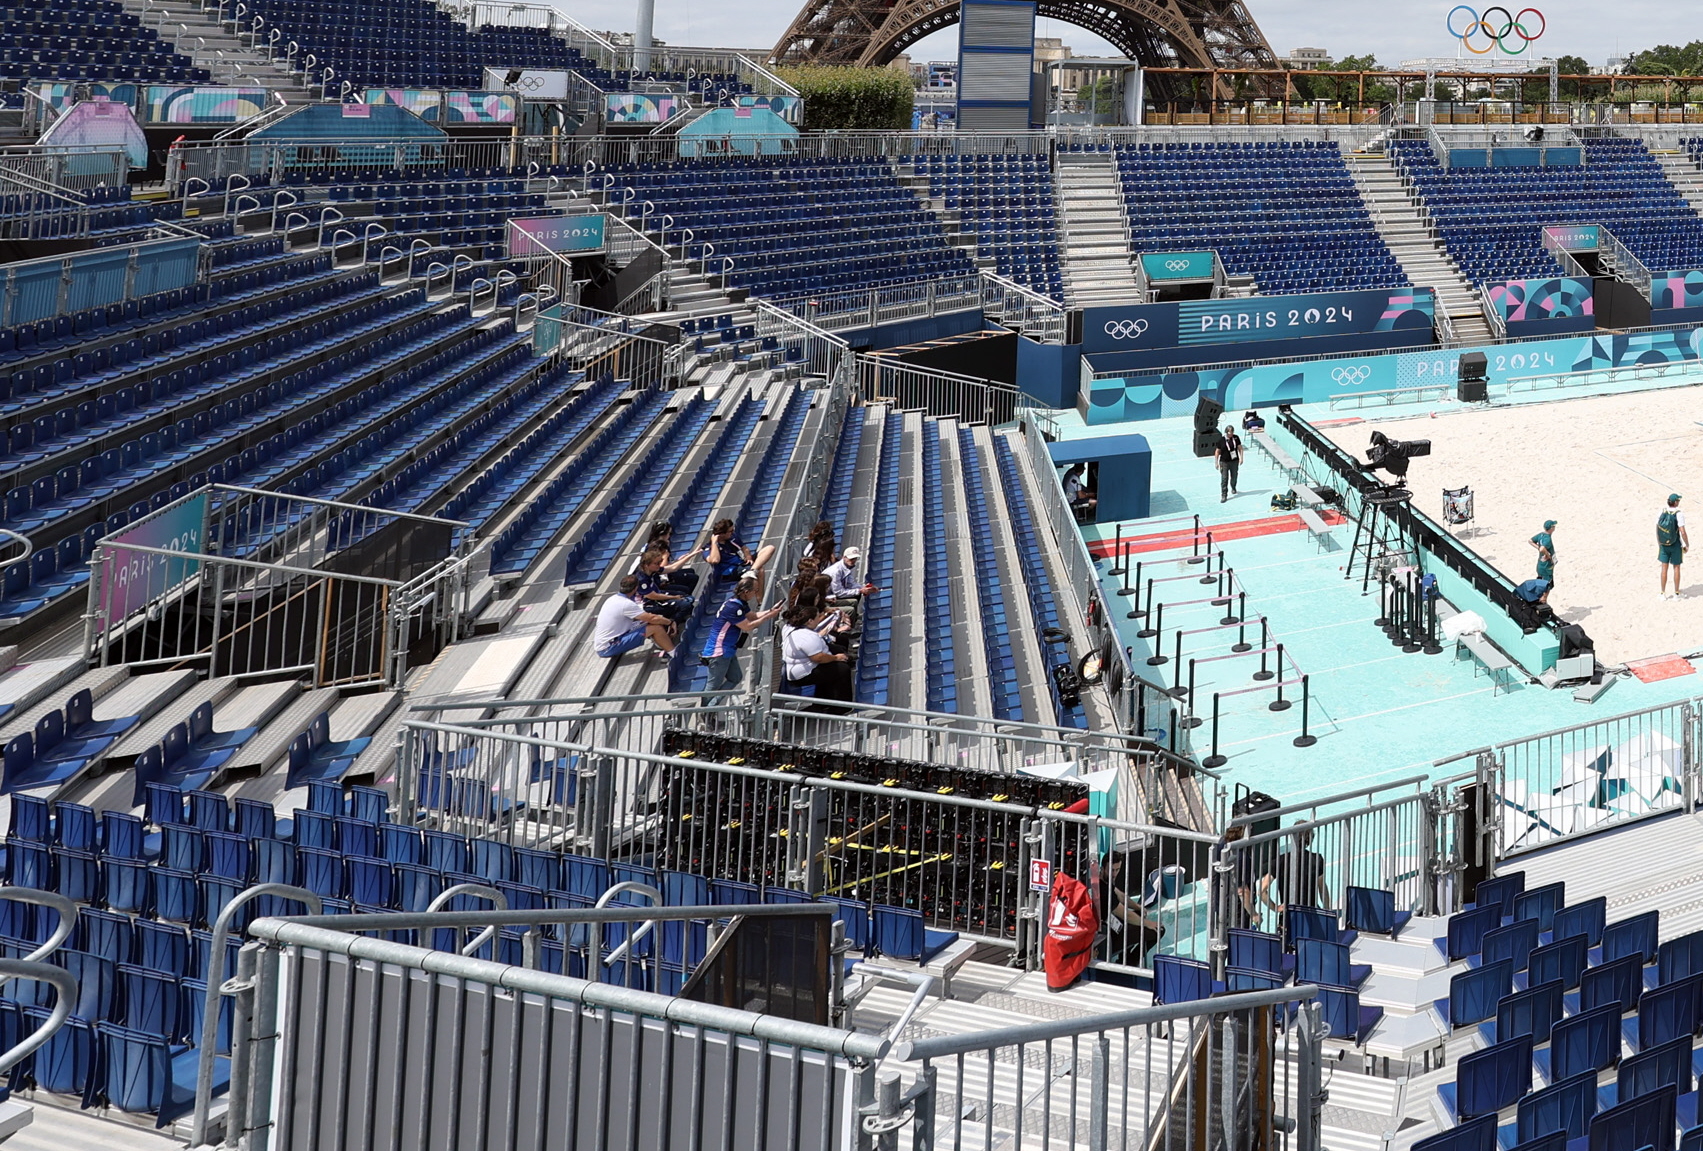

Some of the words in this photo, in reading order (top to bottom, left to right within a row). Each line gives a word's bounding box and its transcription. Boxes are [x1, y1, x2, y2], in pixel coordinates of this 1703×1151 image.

[563, 227, 598, 239] 2024
[1287, 306, 1353, 326] 2024
[1495, 351, 1554, 371] 2024
